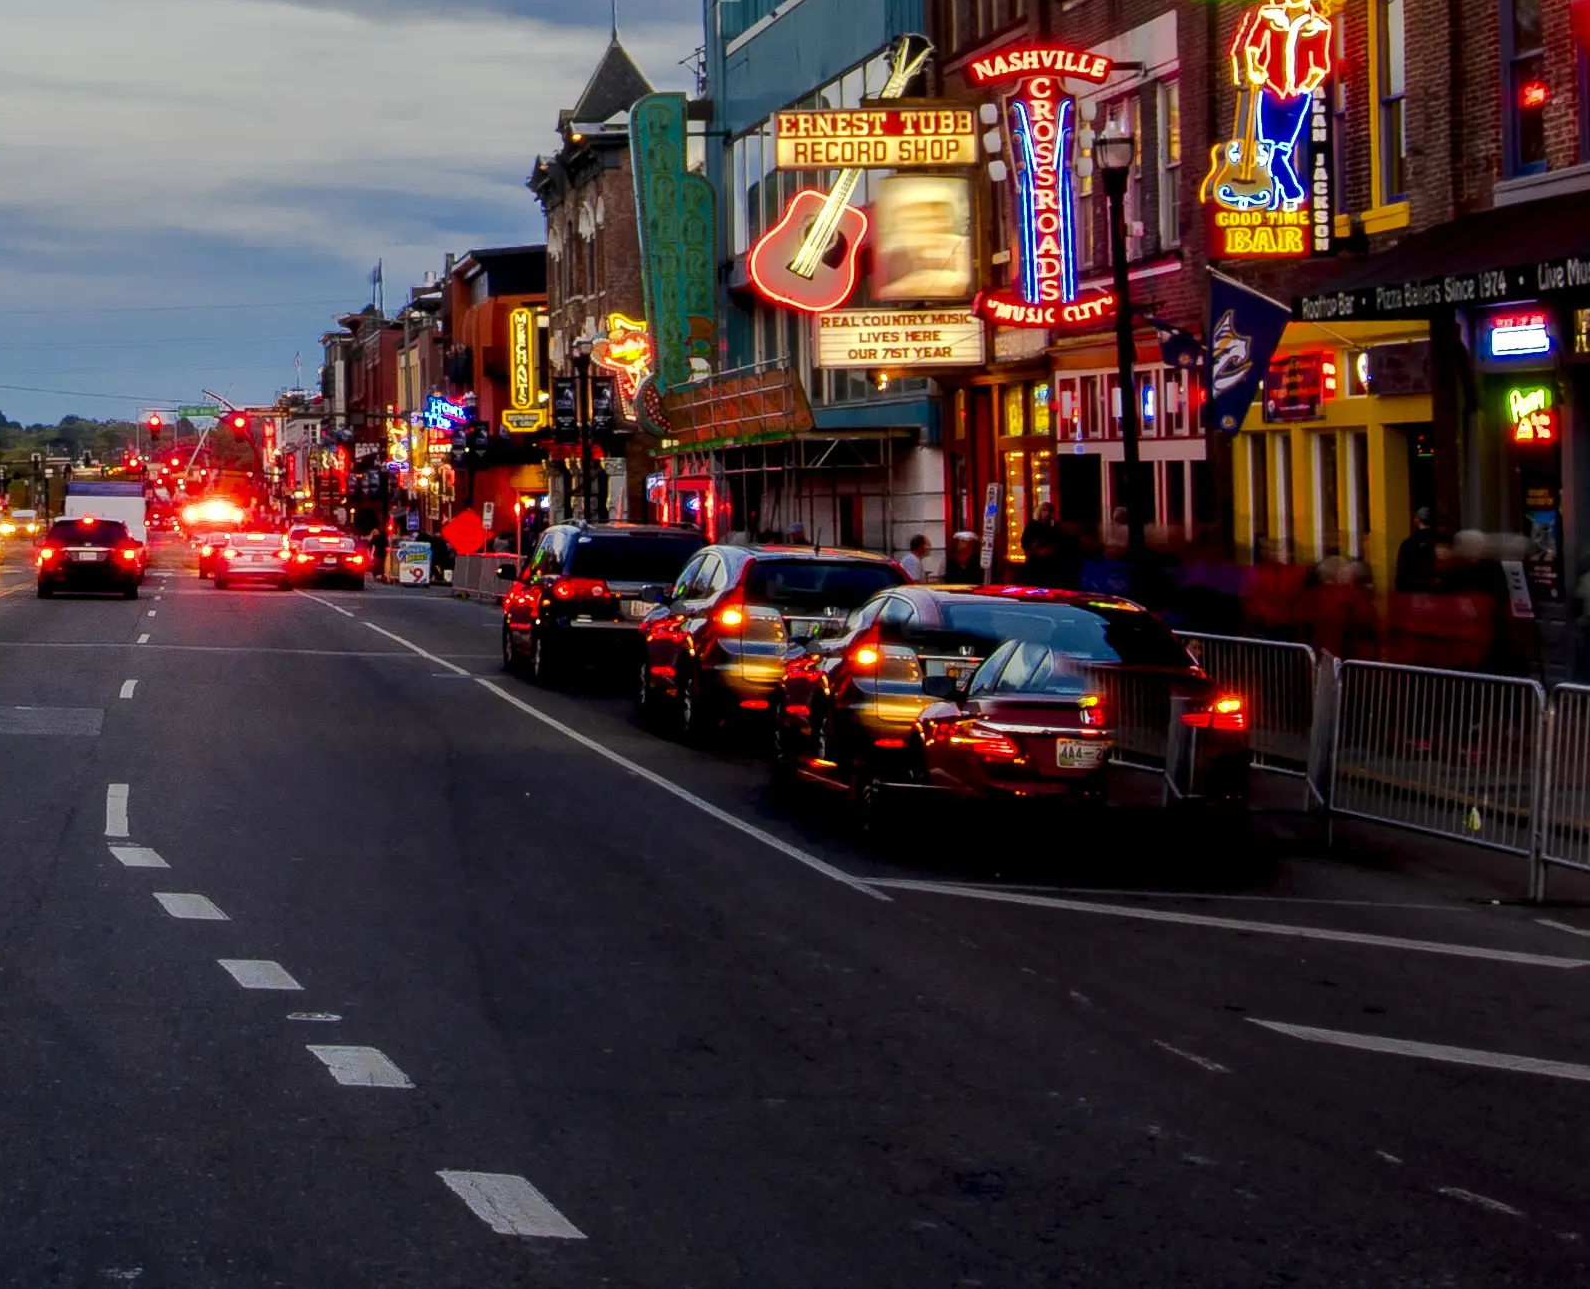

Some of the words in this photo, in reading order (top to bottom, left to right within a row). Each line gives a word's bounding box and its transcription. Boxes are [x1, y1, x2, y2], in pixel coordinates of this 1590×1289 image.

[972, 50, 1107, 81] NASHVILLE
[779, 112, 887, 137] ERNEST
[900, 110, 973, 135] TUBB
[1311, 86, 1327, 142] ALAN
[794, 140, 888, 164] RECORD
[898, 139, 960, 163] SHOP
[1029, 77, 1062, 301] CROSSROADS
[1312, 153, 1330, 251] JACKSON
[1215, 211, 1263, 227] GOOD
[1266, 210, 1310, 225] TIME
[682, 181, 708, 312] PARK
[1225, 226, 1304, 253] BAR
[1338, 292, 1355, 314] Bar
[1376, 285, 1402, 310] Pizza
[1444, 276, 1475, 303] Since
[1537, 262, 1564, 290] Live
[822, 315, 860, 328] REAL
[862, 314, 928, 328] COUNTRY
[931, 313, 973, 326] MUSIC
[858, 332, 900, 343] LIVES
[905, 330, 942, 342] HERE
[514, 313, 528, 406] MERCHANTS
[848, 348, 878, 360] OUR
[882, 347, 911, 359] 71ST
[914, 346, 952, 359] YEAR
